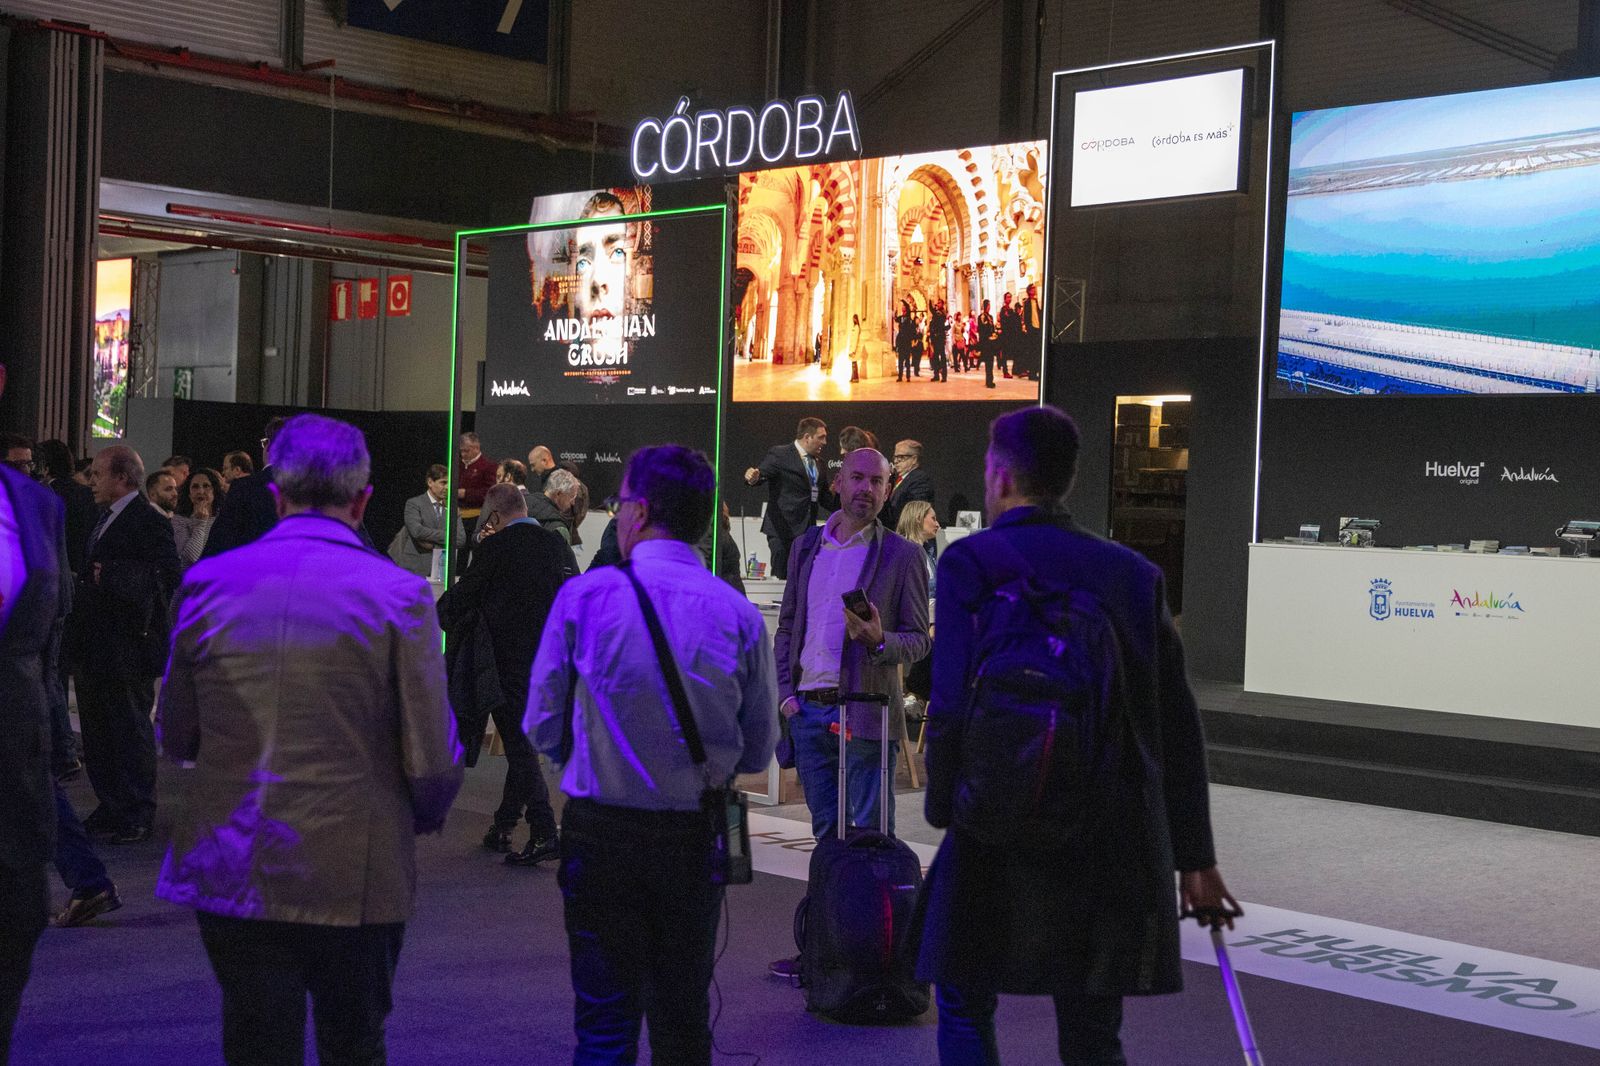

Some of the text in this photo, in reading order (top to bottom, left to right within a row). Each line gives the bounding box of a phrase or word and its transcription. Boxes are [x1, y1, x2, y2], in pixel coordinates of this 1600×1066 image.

[632, 95, 858, 177] CÓRDOBA
[543, 314, 656, 342] ANDALIAN
[1425, 461, 1481, 477] Huelva
[1500, 465, 1559, 483] Andalucía
[1394, 607, 1435, 618] HUELVA
[1450, 589, 1525, 613] Andalucía
[1227, 935, 1578, 1011] TURISMO
[1260, 928, 1558, 994] HUELVA
